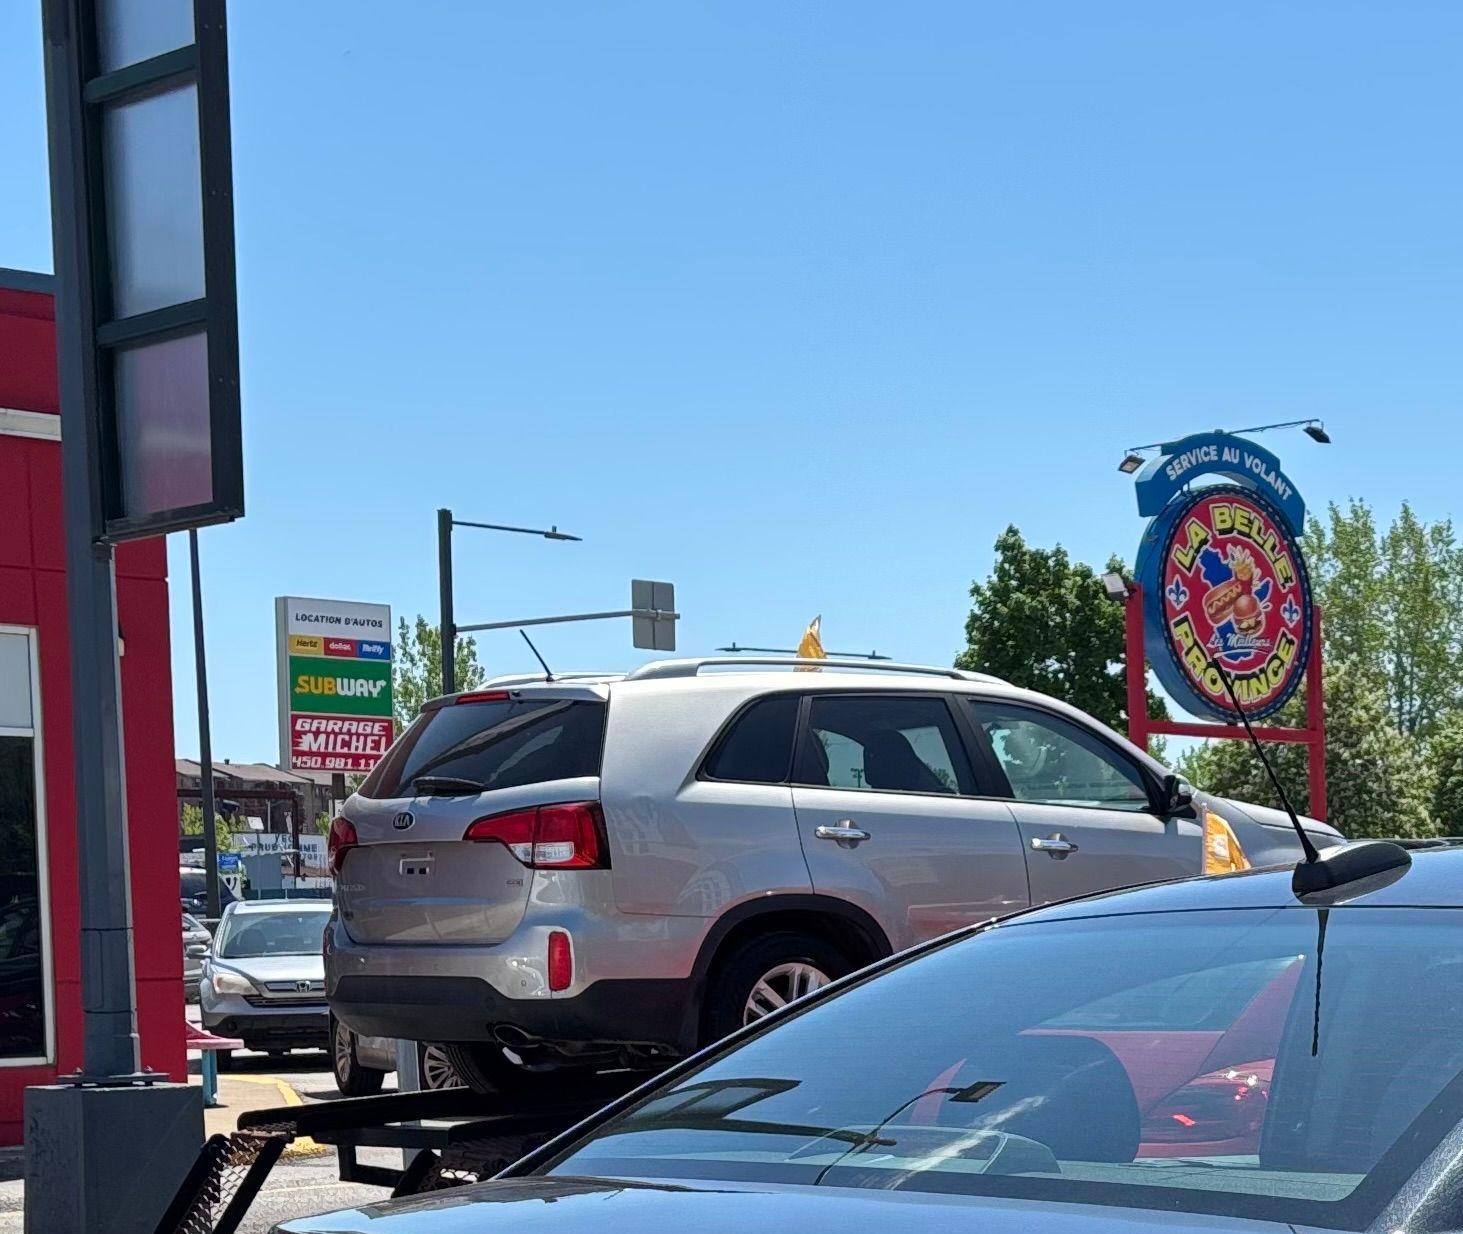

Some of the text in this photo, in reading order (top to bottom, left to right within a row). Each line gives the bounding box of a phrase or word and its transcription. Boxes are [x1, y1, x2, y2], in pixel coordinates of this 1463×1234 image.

[1166, 445, 1293, 500] SERVICE AU VOLANT
[1173, 504, 1295, 590] LA BELLE
[295, 612, 383, 629] LOCATION D'AUTOS
[296, 638, 318, 648] Hertz
[294, 675, 387, 698] SUBWAY
[294, 718, 389, 735] GARAGE
[303, 733, 386, 754] MICHEL
[292, 755, 376, 770] 450.981.11
[394, 813, 411, 827] KIA
